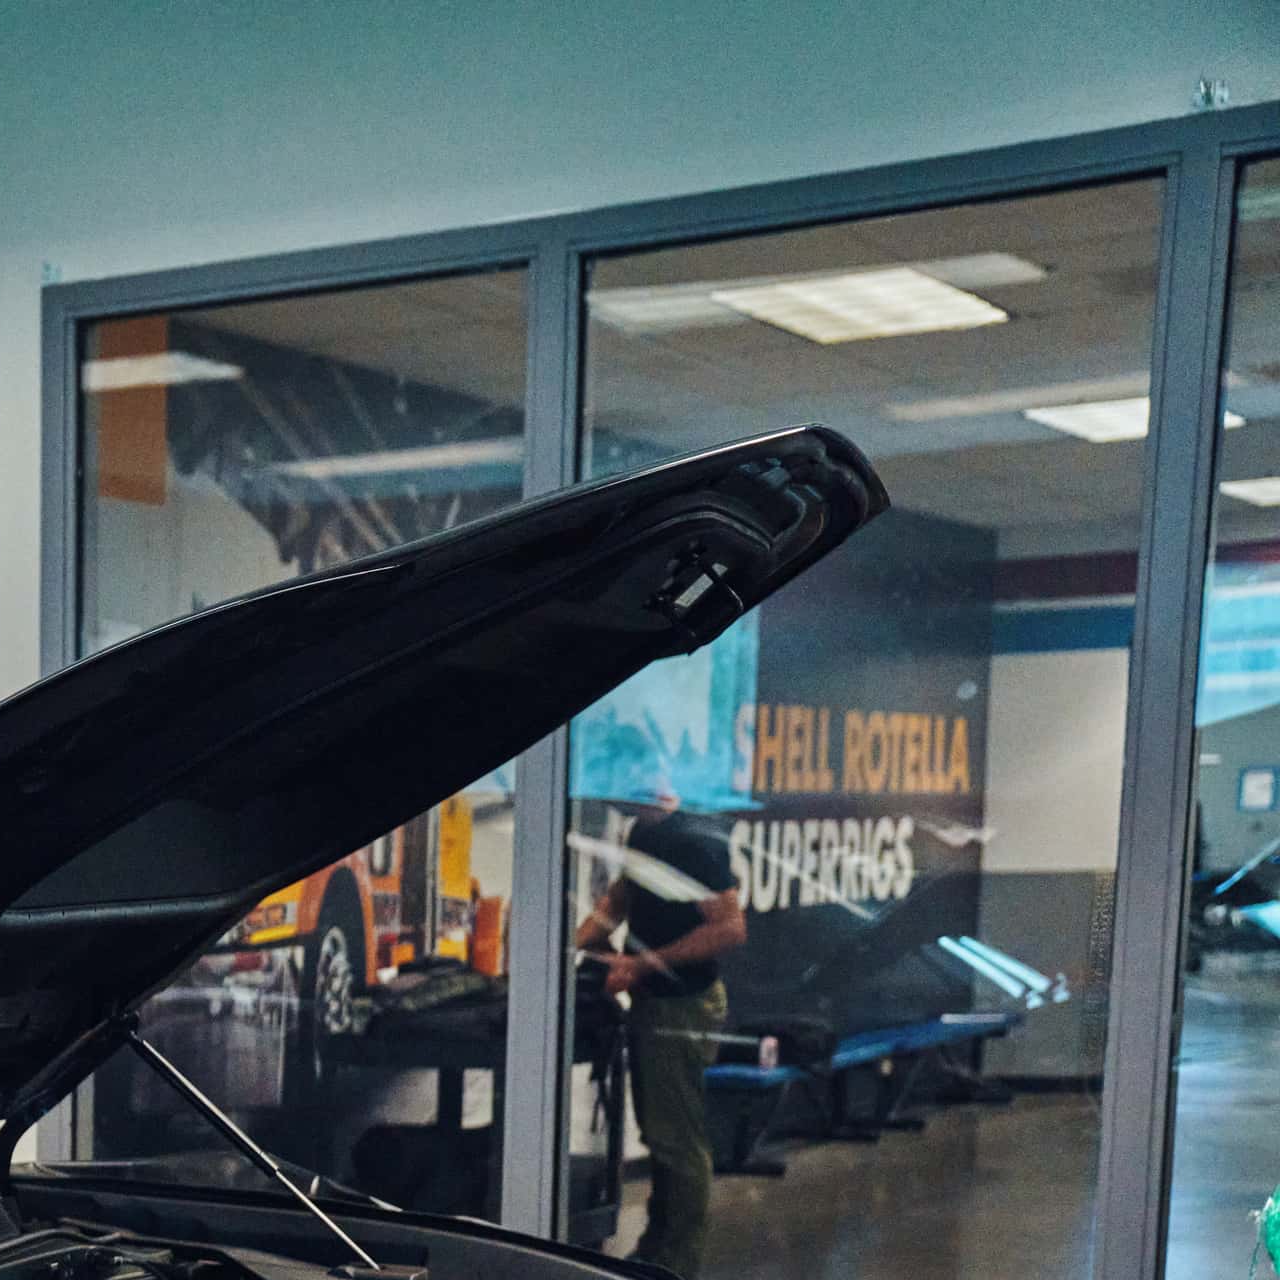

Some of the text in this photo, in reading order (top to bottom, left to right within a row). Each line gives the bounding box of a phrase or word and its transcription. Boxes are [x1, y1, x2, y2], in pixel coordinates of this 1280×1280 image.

[733, 703, 970, 794] SHELL ROTELLA
[729, 816, 915, 913] SUPERRIGS
